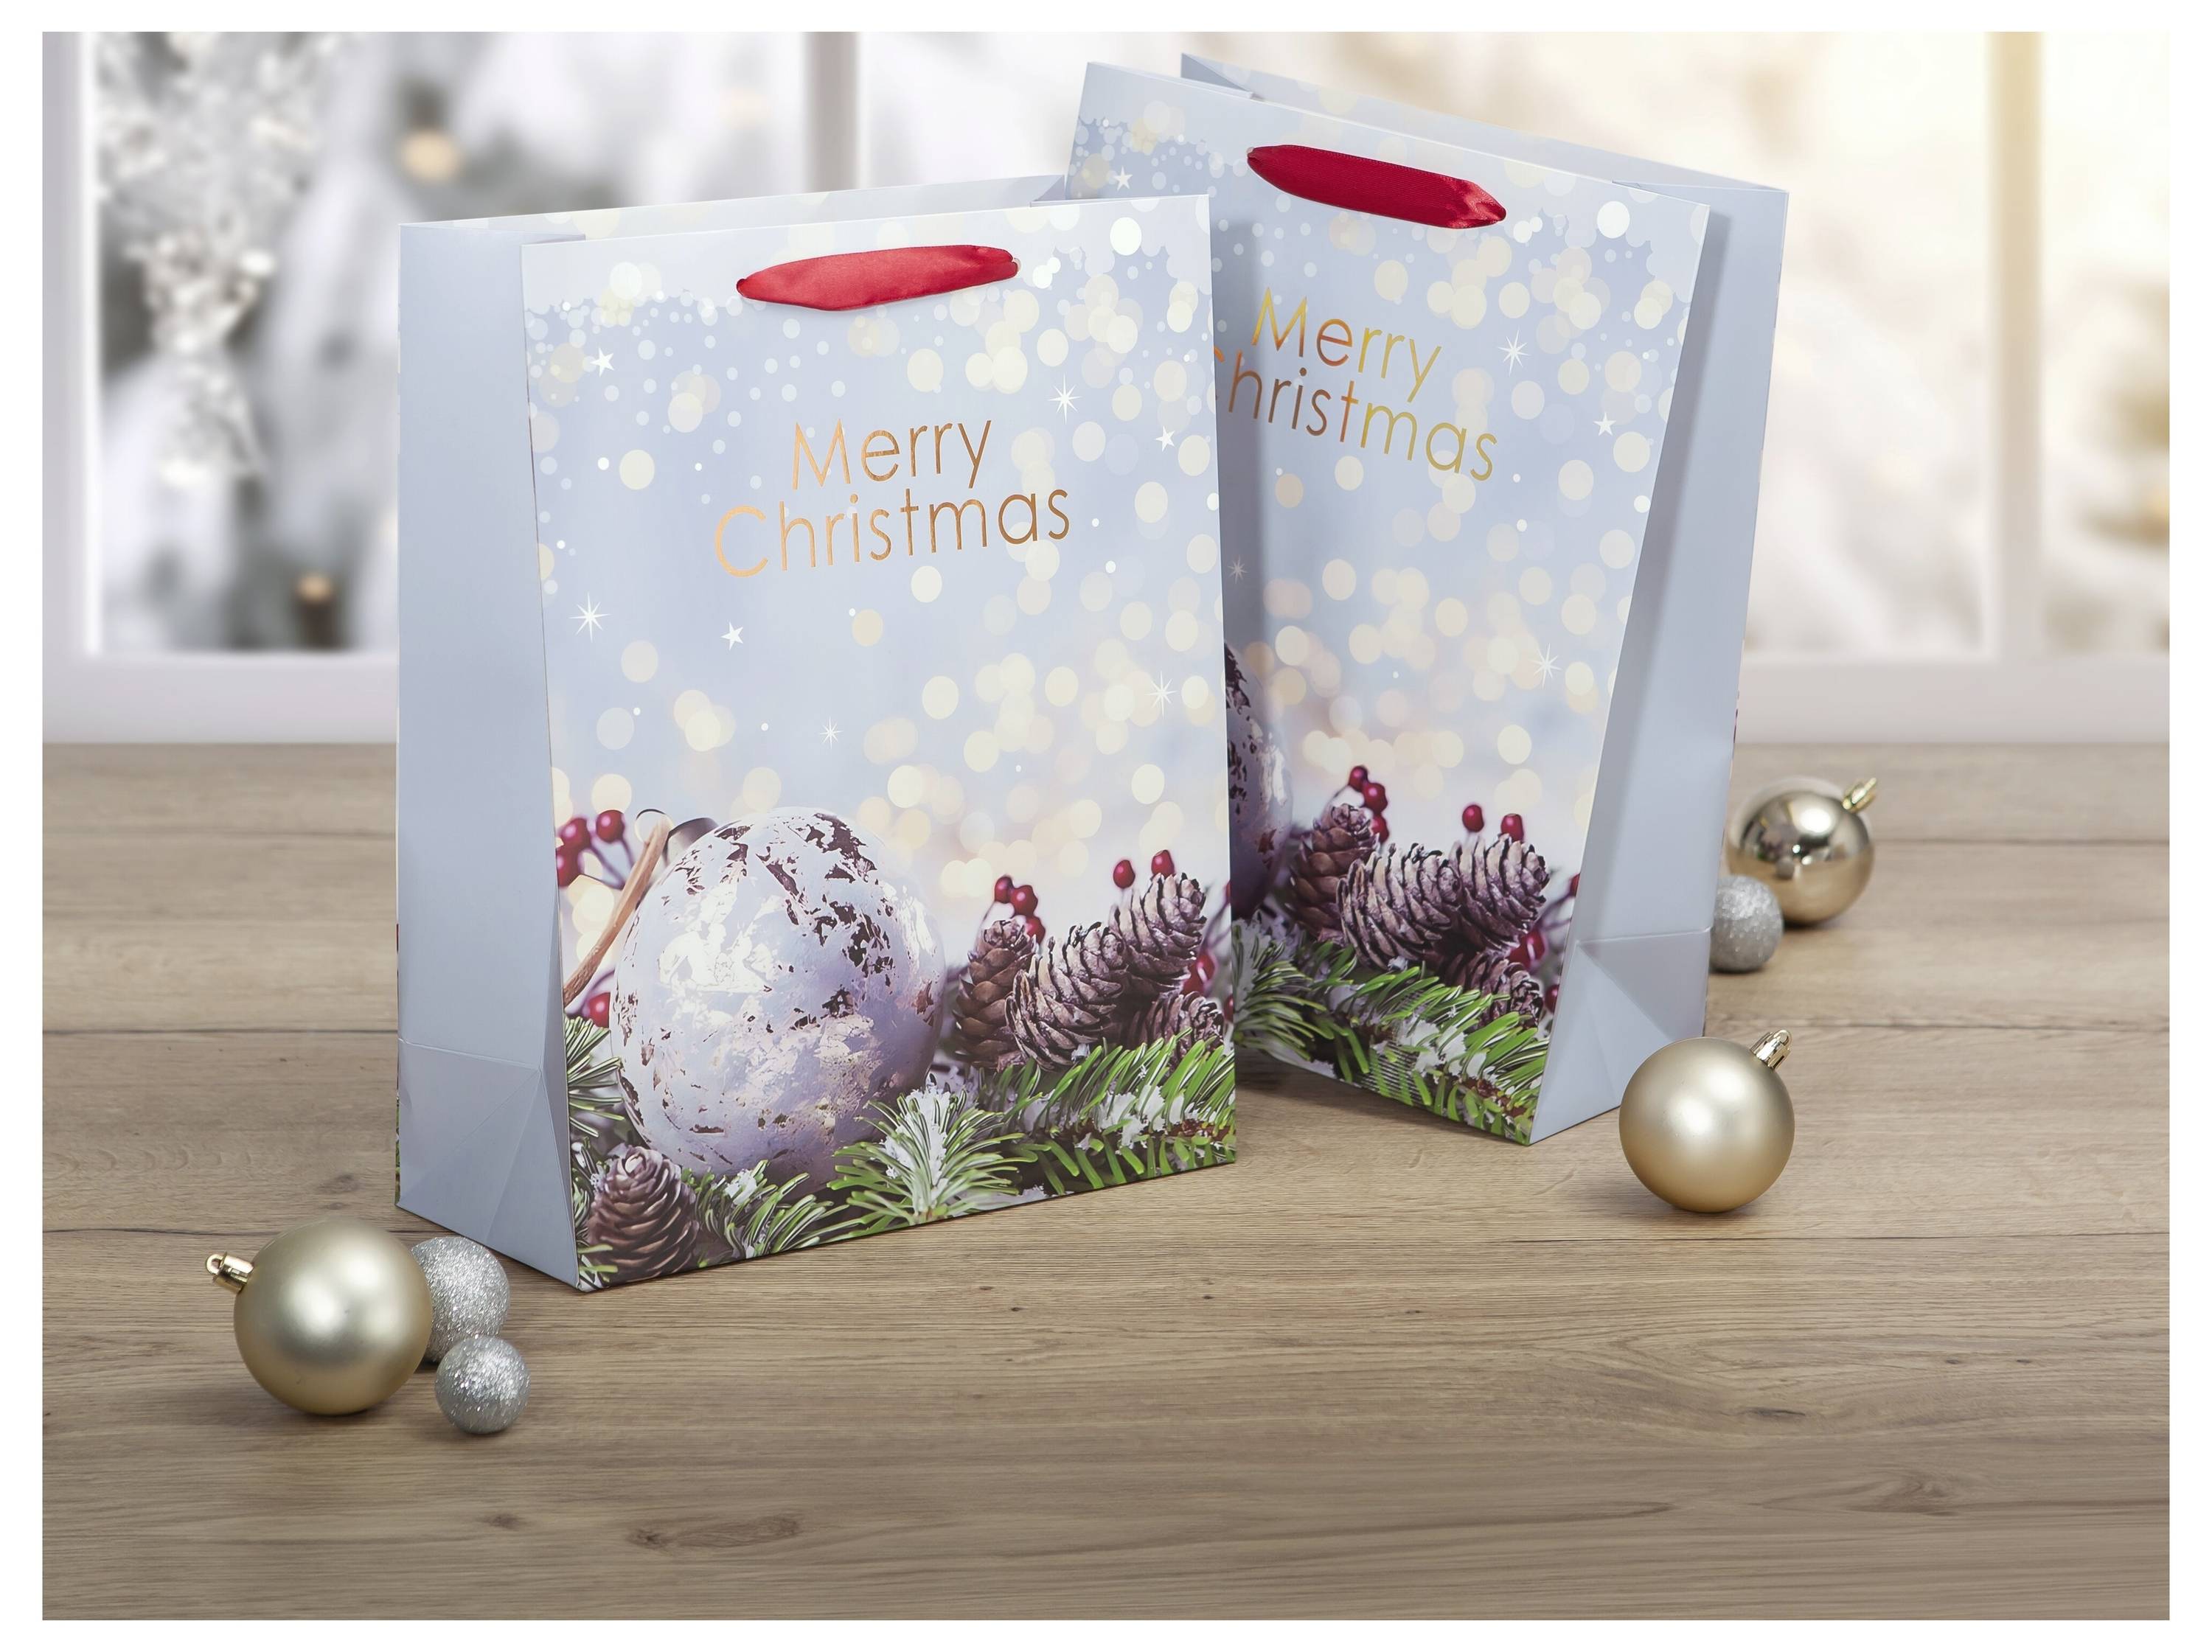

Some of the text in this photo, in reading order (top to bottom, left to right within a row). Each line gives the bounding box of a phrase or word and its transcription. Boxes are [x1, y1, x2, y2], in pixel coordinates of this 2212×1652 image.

[1251, 287, 1442, 402] Merry
[792, 418, 992, 490] Merry
[1213, 345, 1498, 481] hristmas
[714, 488, 1070, 578] Christmas
